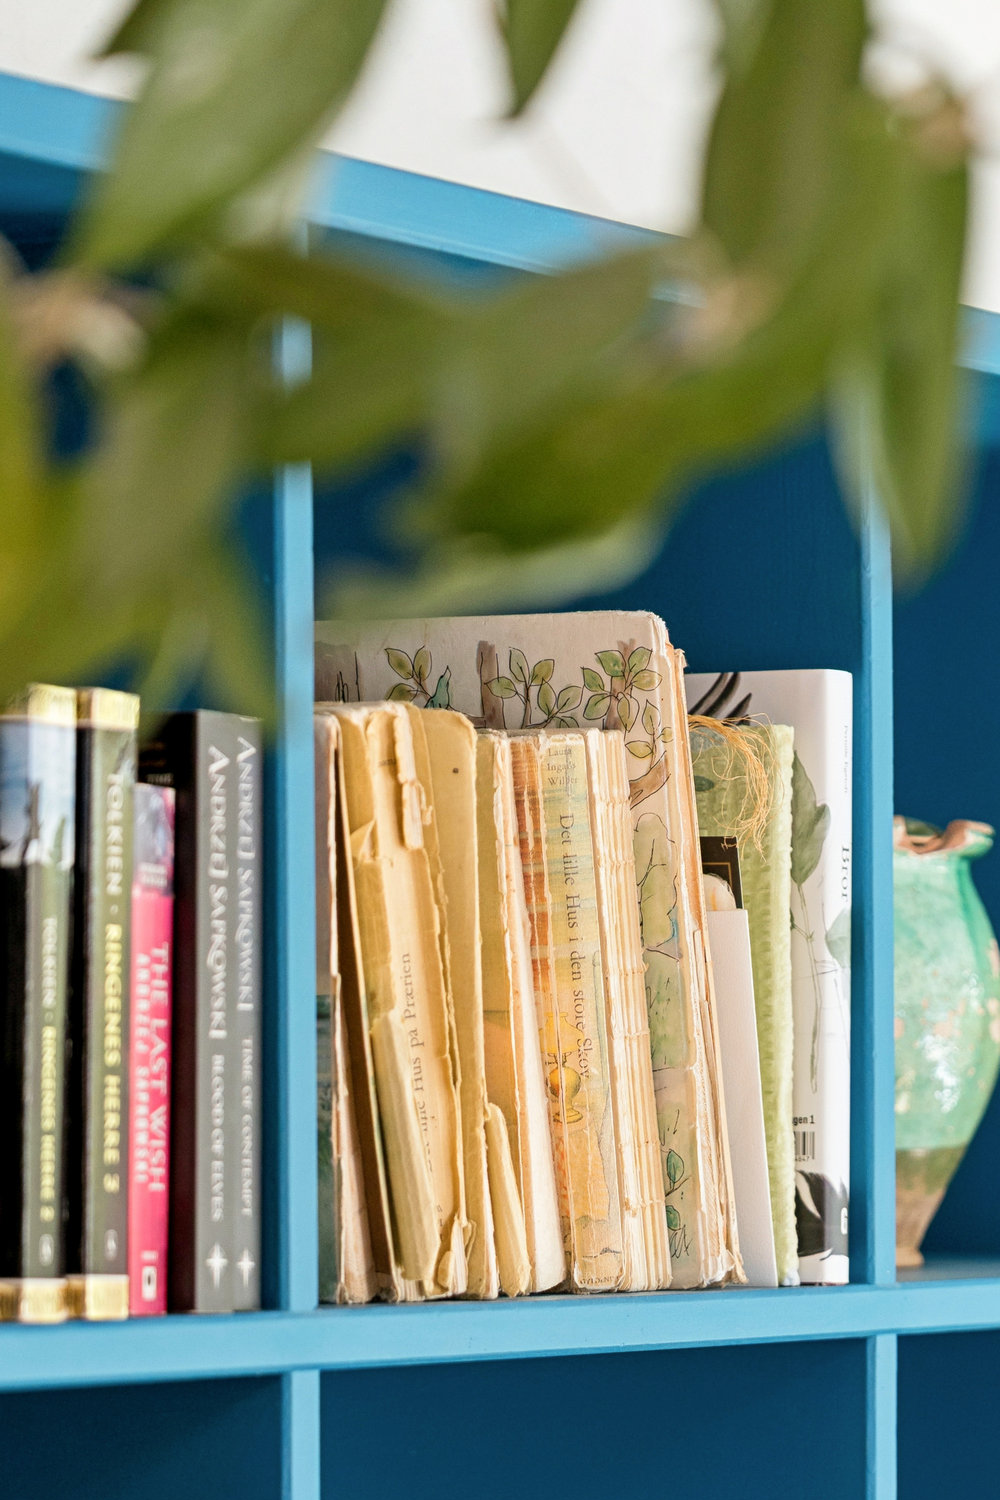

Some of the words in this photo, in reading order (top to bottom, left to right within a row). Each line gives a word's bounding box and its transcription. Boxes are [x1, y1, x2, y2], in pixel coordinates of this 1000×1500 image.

[208, 745, 230, 879] ANDRZEJ
[237, 737, 256, 860] ANDRZEJ
[559, 815, 576, 846] Det
[107, 773, 122, 896] TOLKIEN
[562, 854, 579, 887] lille
[842, 846, 850, 902] Bror
[235, 867, 254, 1012] SAPKOWSKI
[566, 896, 582, 929] Hus
[42, 917, 57, 1007] TOLKIEN
[151, 941, 168, 1006] THE
[207, 884, 228, 1040] SAPKOWSKI
[402, 953, 418, 1020] Prærien
[571, 951, 587, 981] den
[105, 924, 122, 1067] RINGENES
[573, 990, 587, 1029] store
[41, 1025, 57, 1131] RINGENES
[150, 1018, 168, 1096] LAST
[242, 1037, 253, 1083] TIME
[576, 1037, 593, 1080] Skov
[104, 1075, 120, 1165] HERRE
[211, 1054, 225, 1127] BLOOD
[242, 1086, 253, 1109] OF
[40, 1134, 56, 1200] HERRE
[148, 1104, 167, 1192] WISH
[211, 1128, 225, 1157] OF
[241, 1114, 253, 1217] CONTEMPT
[104, 1173, 120, 1193] 3
[211, 1160, 225, 1222] ELVES
